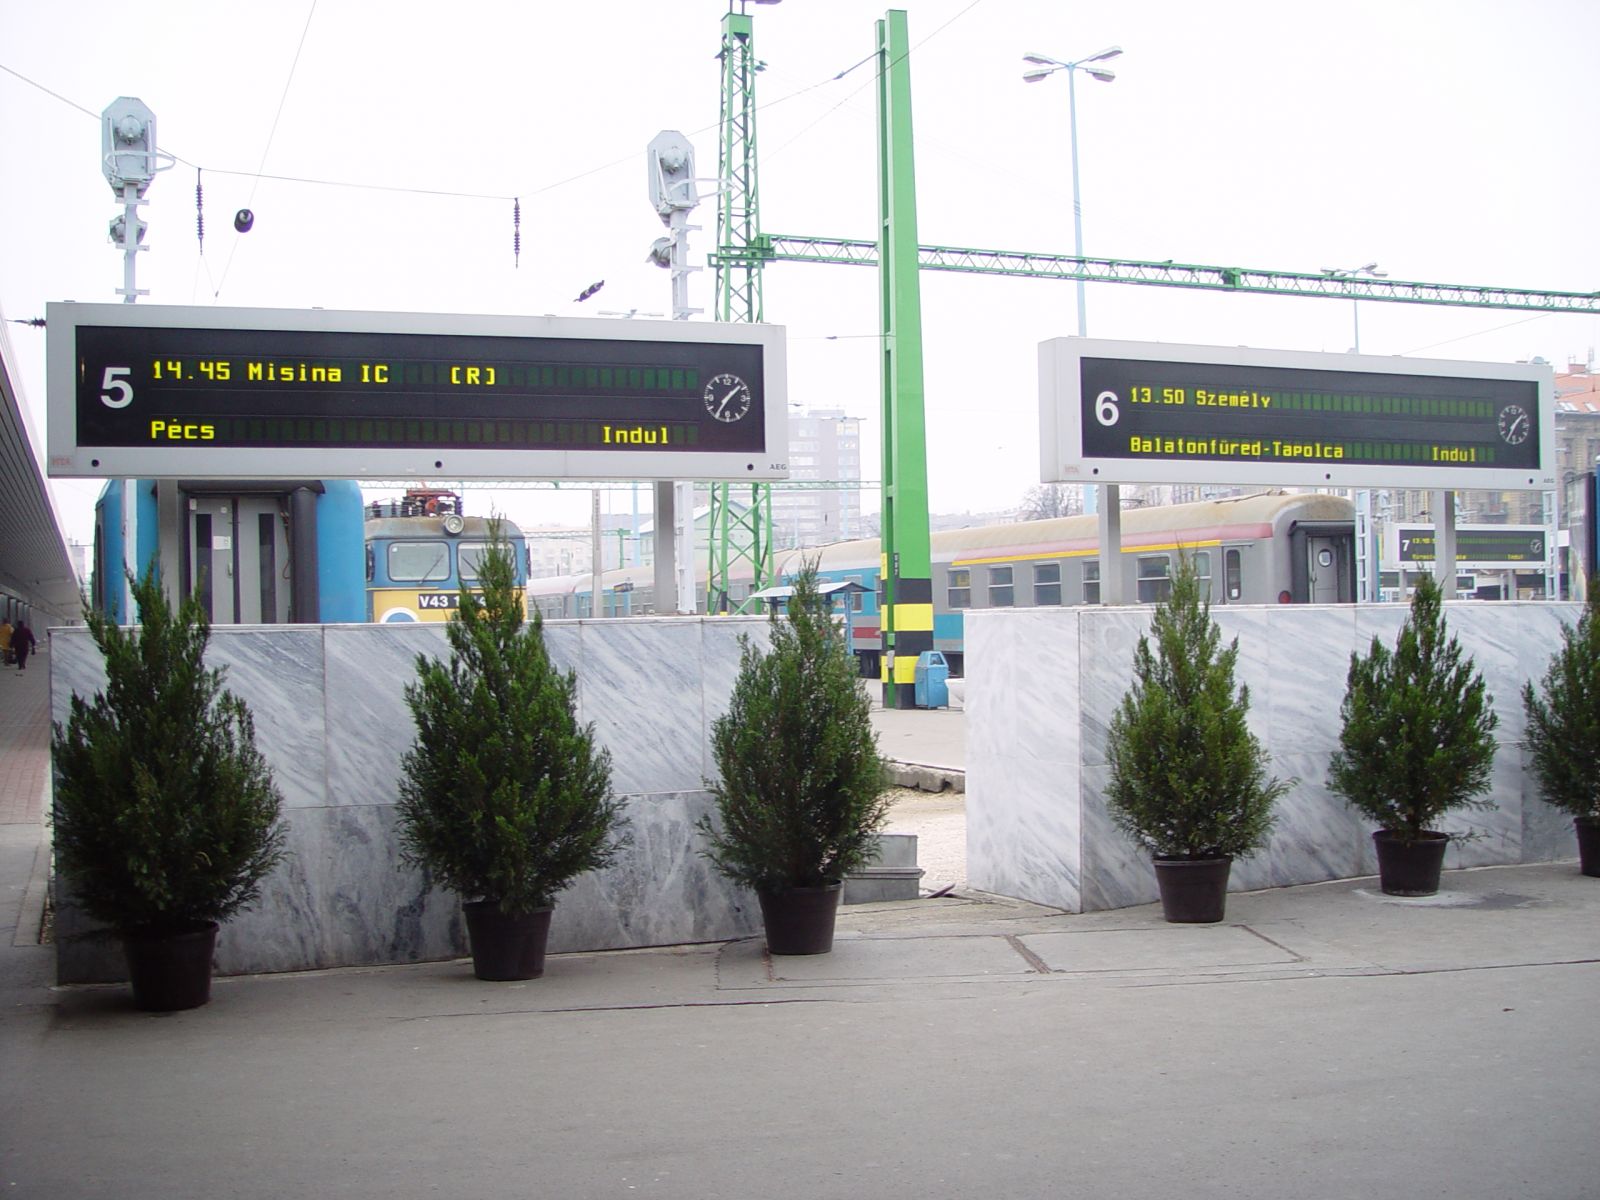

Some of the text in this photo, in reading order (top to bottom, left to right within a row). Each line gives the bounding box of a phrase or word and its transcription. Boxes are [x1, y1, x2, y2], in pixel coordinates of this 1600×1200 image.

[153, 360, 231, 381] 14.45
[248, 362, 342, 383] Misina
[361, 364, 389, 384] IC
[100, 367, 134, 410] 5
[1130, 387, 1271, 408] 13.50 Személy
[1095, 390, 1120, 427] 6
[151, 418, 669, 445] Pécs Indul
[1129, 435, 1476, 462] Balatonfüred-Tapolca Indul
[769, 463, 787, 471] AEG
[1401, 539, 1410, 552] 7
[419, 595, 449, 608] V43
